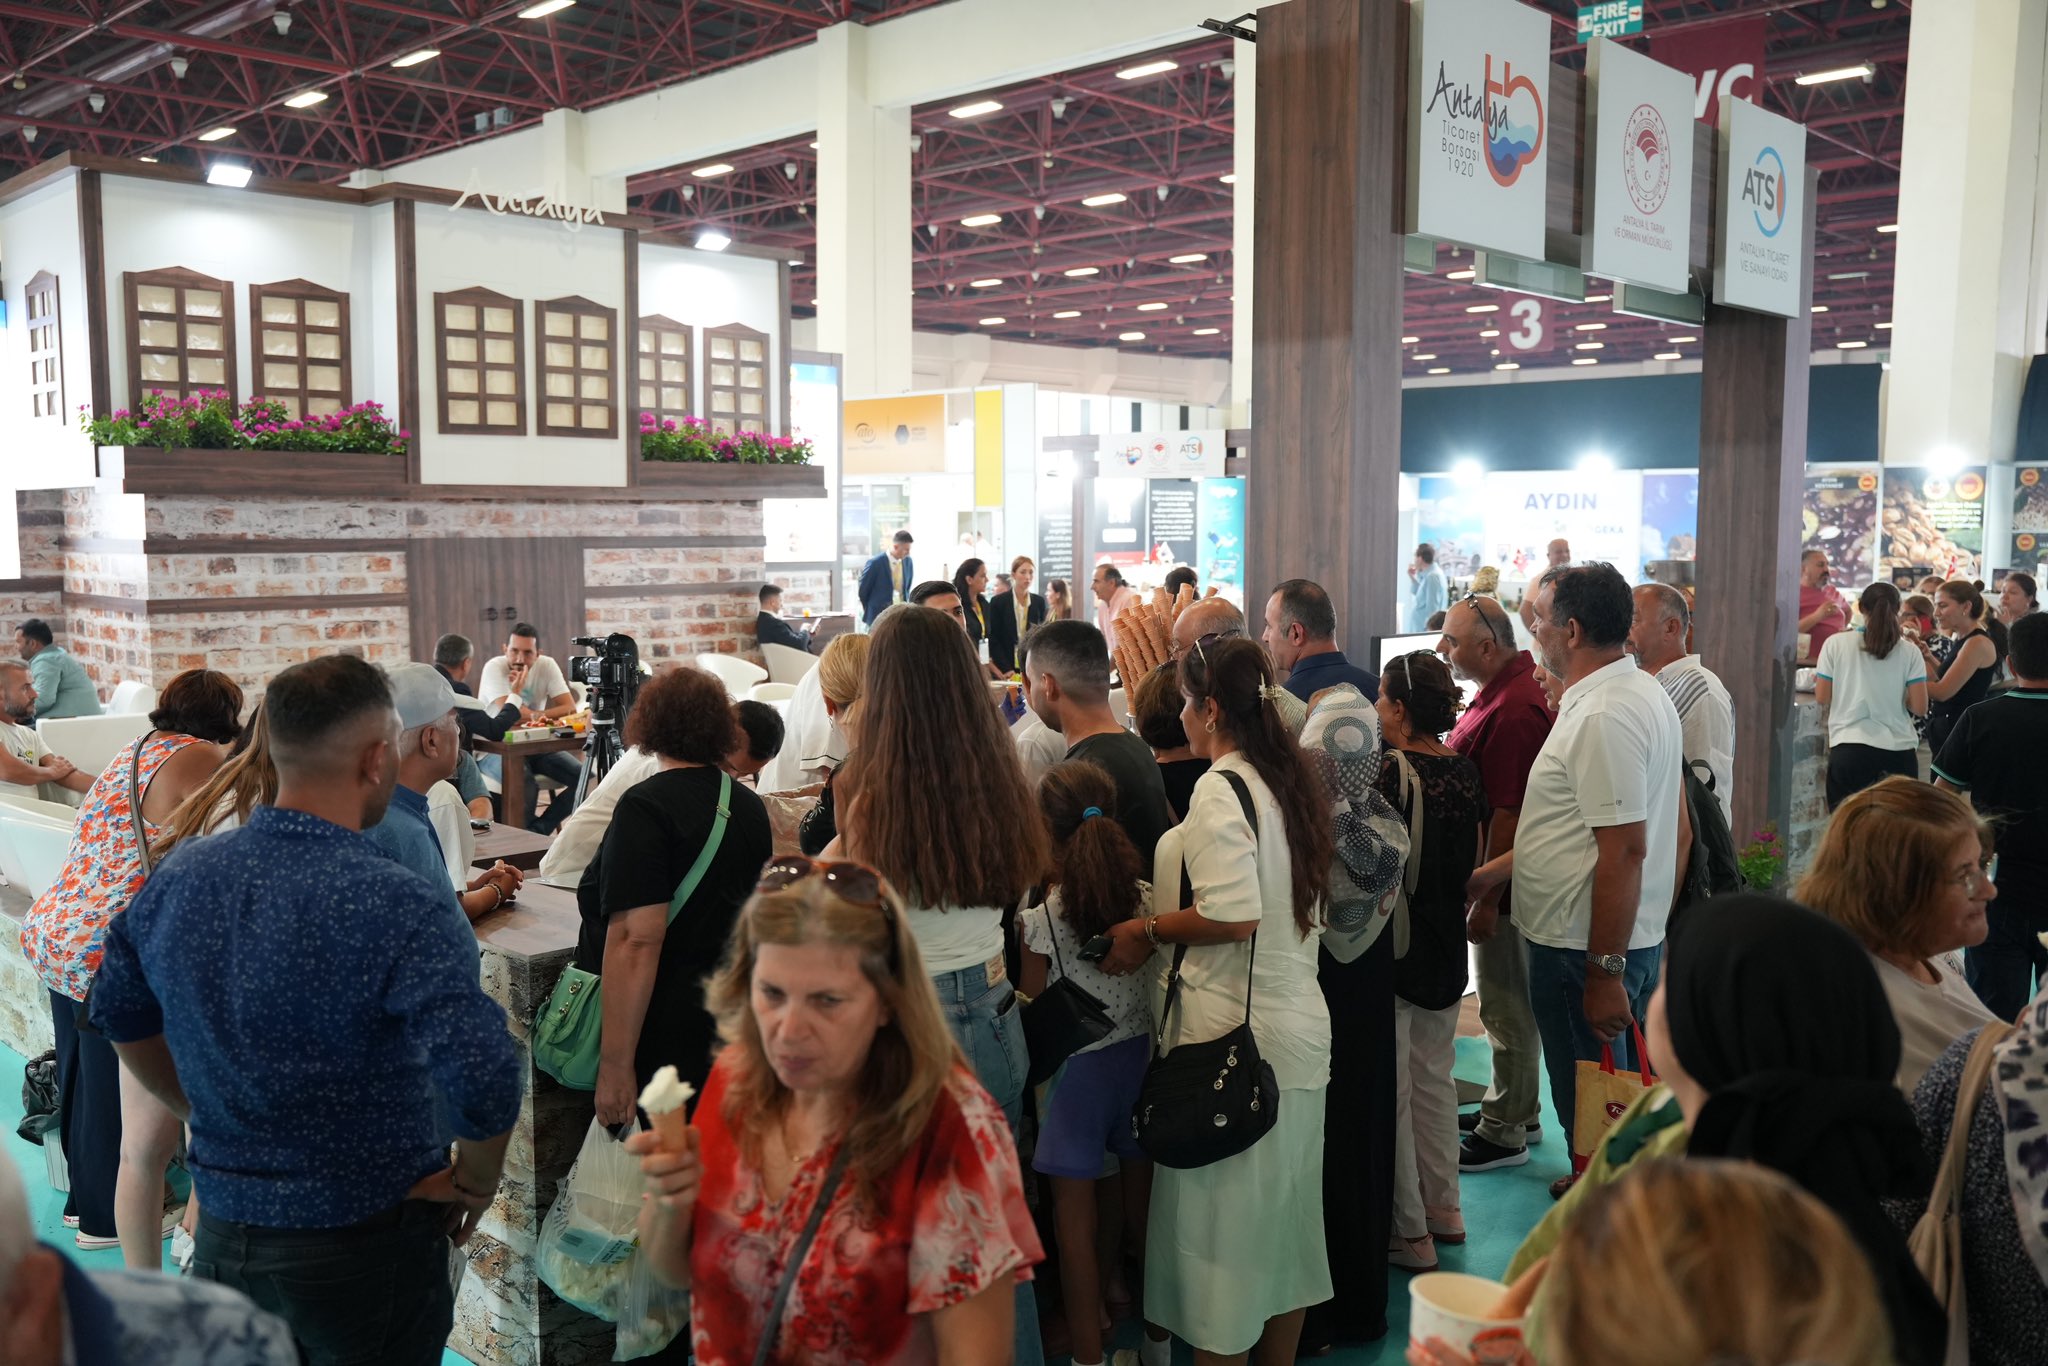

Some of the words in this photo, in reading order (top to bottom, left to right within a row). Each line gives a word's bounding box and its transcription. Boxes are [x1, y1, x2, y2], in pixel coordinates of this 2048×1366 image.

[1593, 1, 1628, 21] FIRE
[1593, 18, 1628, 37] EXIT
[1426, 60, 1509, 141] Antalya
[1442, 119, 1480, 144] Ticaret
[1441, 137, 1480, 162] Borsası
[1448, 157, 1474, 178] 1920
[448, 167, 605, 233] Antalya
[1623, 214, 1644, 228] ANTALYA
[1621, 228, 1641, 242] ORMAN
[1509, 299, 1543, 350] 3
[1524, 493, 1598, 510] AYDIN
